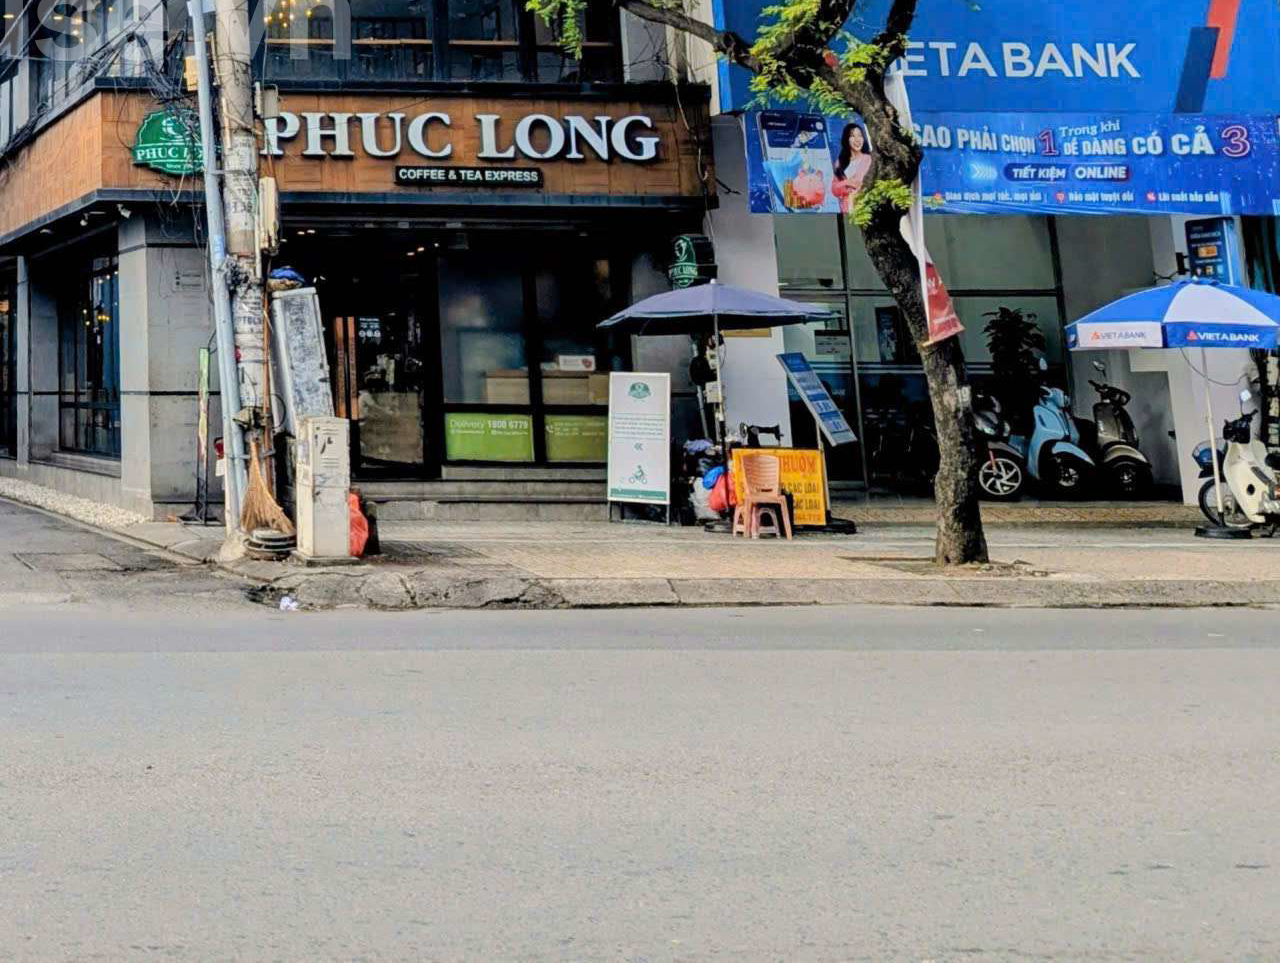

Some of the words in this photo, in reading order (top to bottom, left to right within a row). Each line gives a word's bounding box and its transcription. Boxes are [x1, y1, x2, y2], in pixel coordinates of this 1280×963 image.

[895, 42, 1141, 78] ETABANK
[260, 112, 453, 159] PHUC
[476, 114, 660, 162] LONG
[1060, 125, 1098, 138] Trong
[1100, 121, 1121, 134] khi
[912, 124, 951, 148] SAO
[958, 125, 998, 151] PHẢI
[1002, 132, 1036, 156] CHỌN
[1039, 130, 1059, 156] 1
[1082, 135, 1125, 156] DÀNG
[1132, 130, 1163, 156] CÓ
[1171, 125, 1215, 156] CẢ
[1221, 125, 1250, 157] 3
[136, 147, 179, 160] PHUC
[399, 169, 445, 180] COFFEE
[448, 170, 457, 180] &
[459, 170, 483, 181] TEA
[485, 170, 539, 182] EXPRESS
[1012, 164, 1037, 179] TIẾT
[1038, 166, 1066, 182] KIỆM
[1075, 166, 1128, 180] ONLINE
[1196, 332, 1260, 342] VIETABANK
